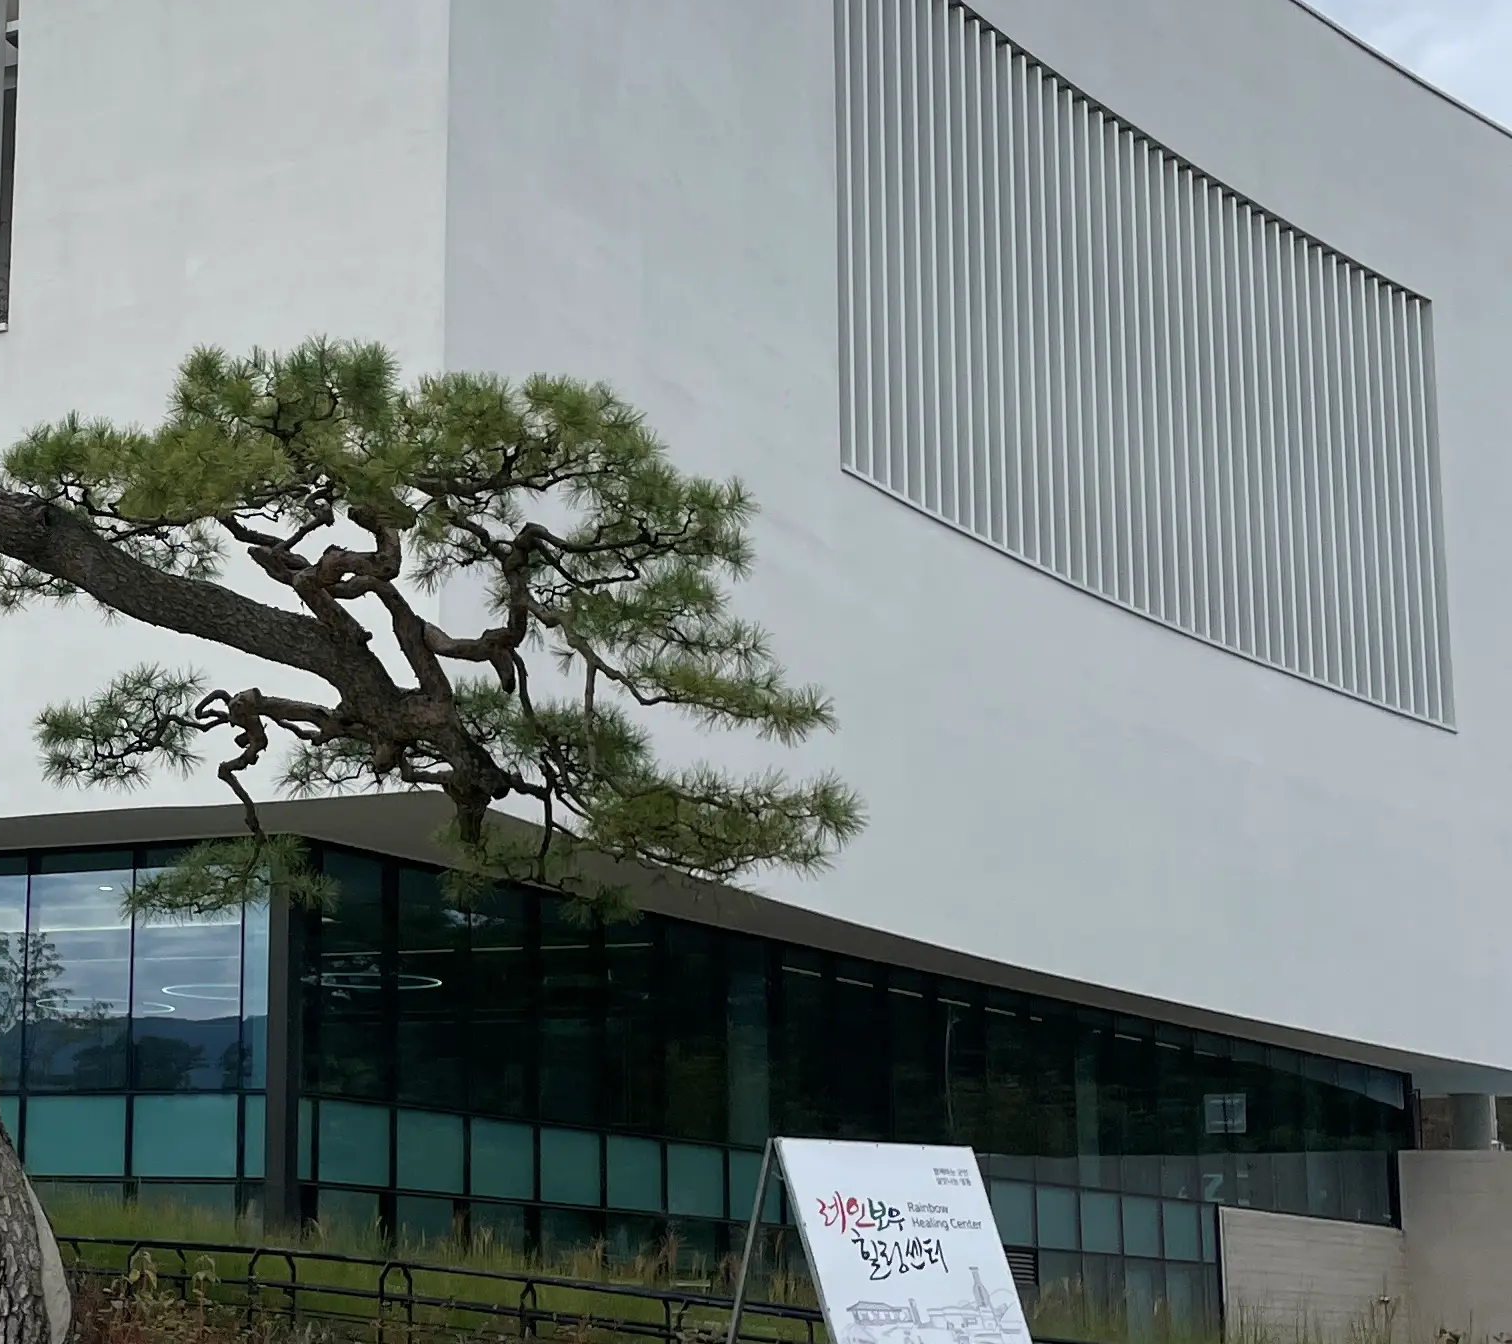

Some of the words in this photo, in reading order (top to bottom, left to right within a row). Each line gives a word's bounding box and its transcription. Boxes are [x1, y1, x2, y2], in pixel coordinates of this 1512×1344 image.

[816, 1190, 906, 1235] 레인보우
[907, 1202, 949, 1214] Rainbow
[910, 1216, 950, 1231] Healing
[950, 1219, 982, 1230] Center
[850, 1227, 949, 1281] 힐링센터
